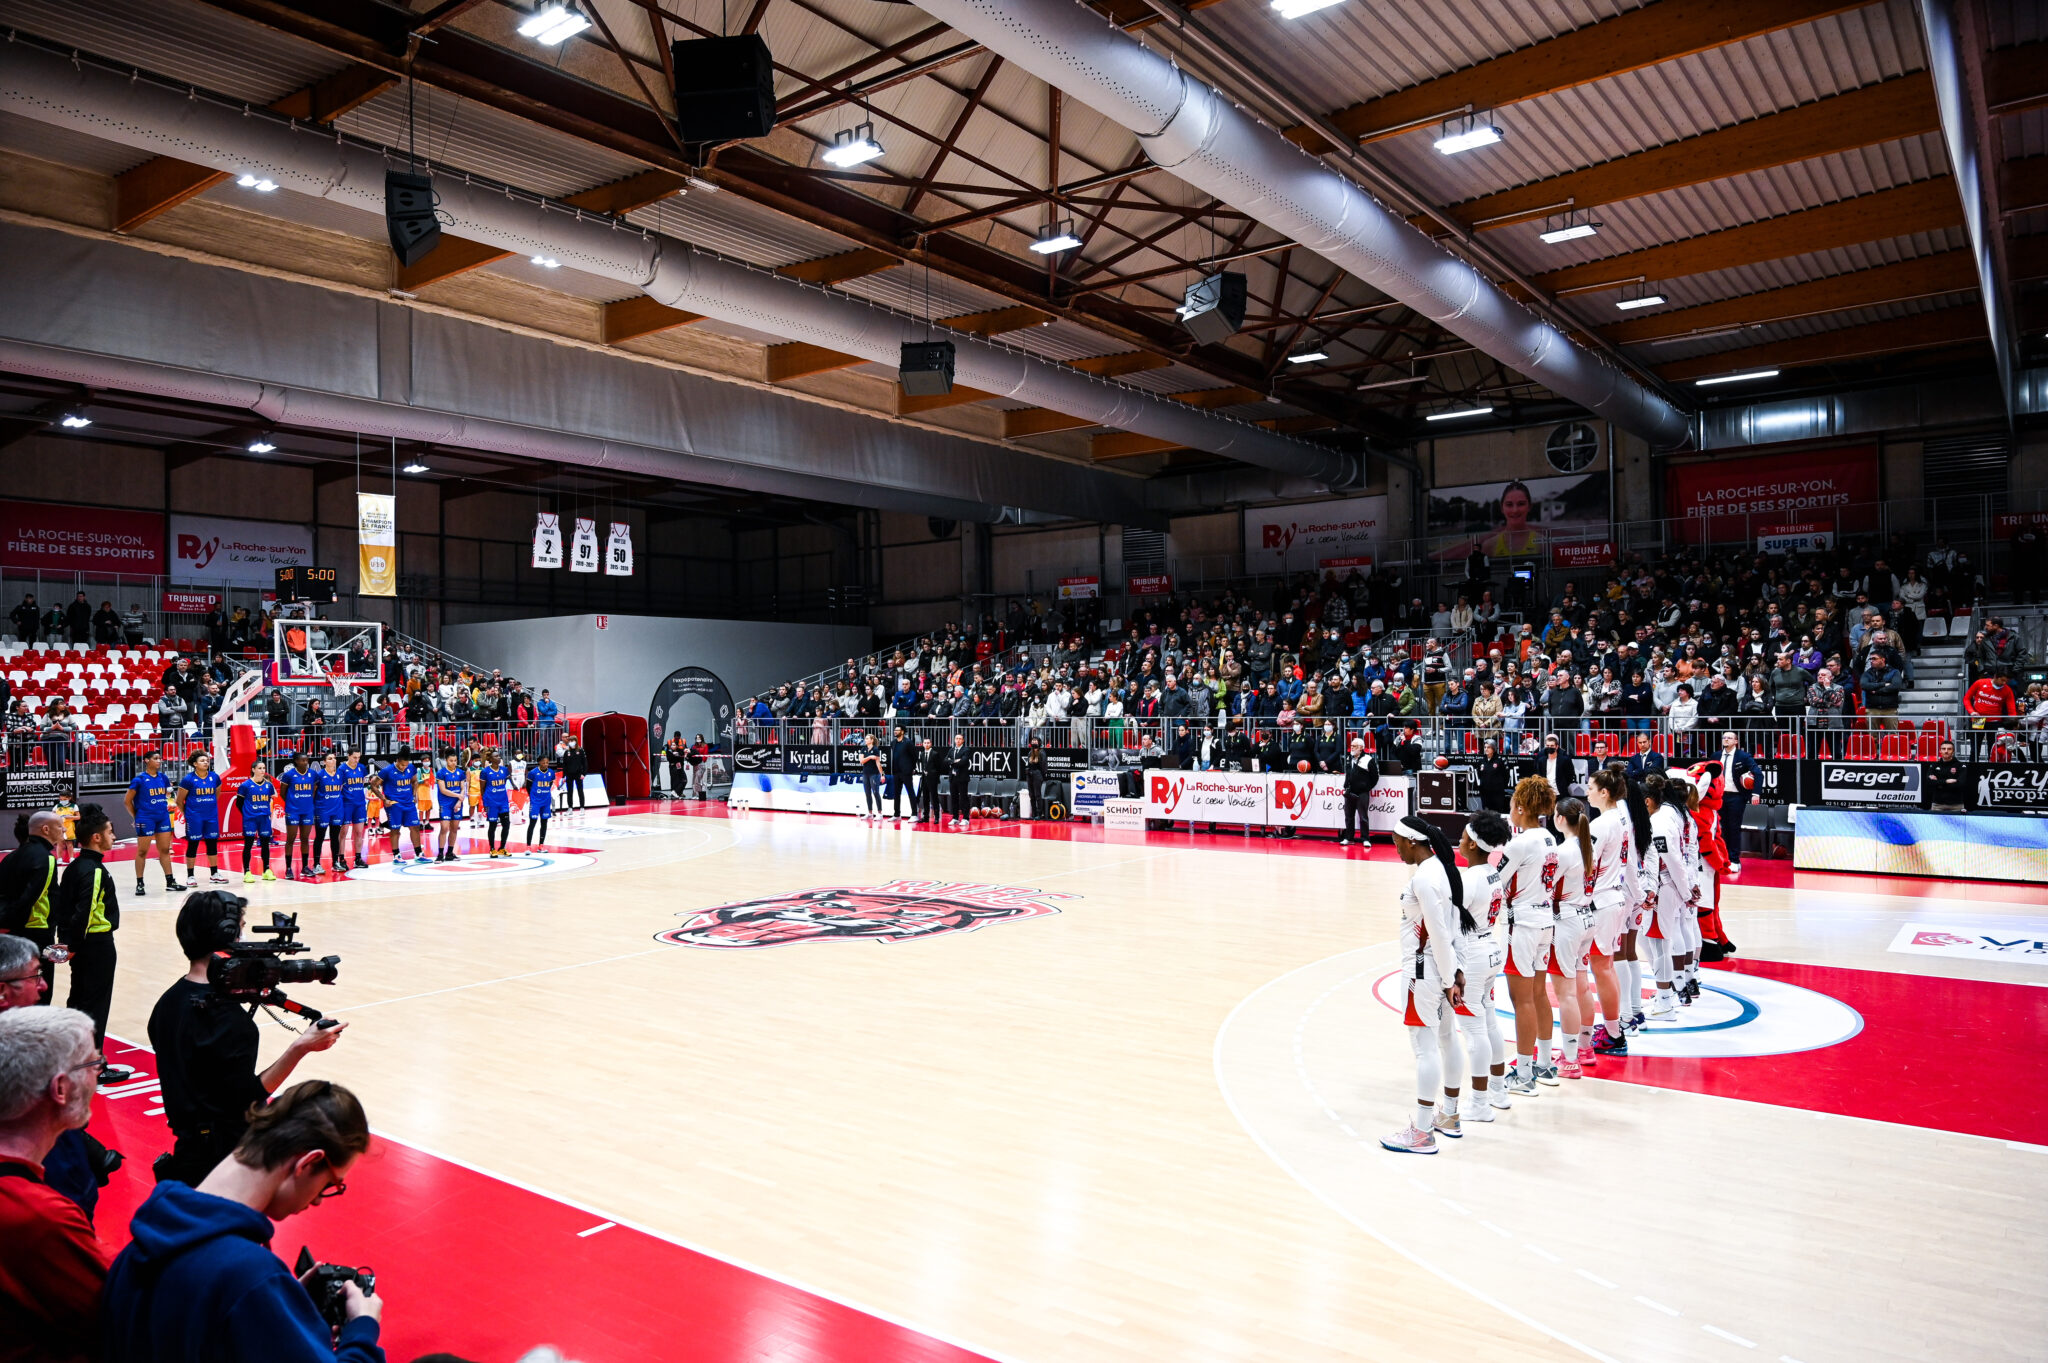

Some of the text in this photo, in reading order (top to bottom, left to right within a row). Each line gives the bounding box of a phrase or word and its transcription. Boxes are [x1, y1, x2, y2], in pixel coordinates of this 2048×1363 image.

[1697, 479, 1836, 502] LA ROCHE-SUR-YON,
[1687, 493, 1848, 517] FIÈRE DE SES SPORTIFS
[1308, 520, 1376, 532] Roche-sur-Yon
[1775, 524, 1814, 533] TRIBUNE
[18, 528, 145, 547] LA ROCHE-SUR-YON,
[1342, 532, 1368, 541] Vendée
[8, 539, 155, 560] FIÈRE DE SES SPORTIFS
[234, 542, 306, 555] Roche-sur-Yon
[545, 540, 552, 554] 2
[1559, 544, 1611, 556] TRIBUNE A
[1765, 538, 1808, 550] SUPER
[580, 545, 591, 559] 97
[614, 548, 626, 563] 50
[230, 553, 239, 562] Le
[270, 554, 300, 565] Vendée
[306, 568, 336, 581] 5:00
[1162, 576, 1168, 584] A
[168, 594, 217, 605] TRIBUNE D
[790, 750, 829, 767] Kyriad
[7, 771, 75, 780] IMPRIMERIE
[1087, 776, 1118, 785] SACHOT
[1829, 769, 1900, 786] Berger
[1196, 782, 1262, 793] Roche-sur-Yon
[1193, 795, 1201, 804] Le
[1228, 794, 1256, 807] Vendée
[1876, 792, 1916, 801] Location
[1323, 801, 1332, 810] Le
[1368, 802, 1395, 813] endée
